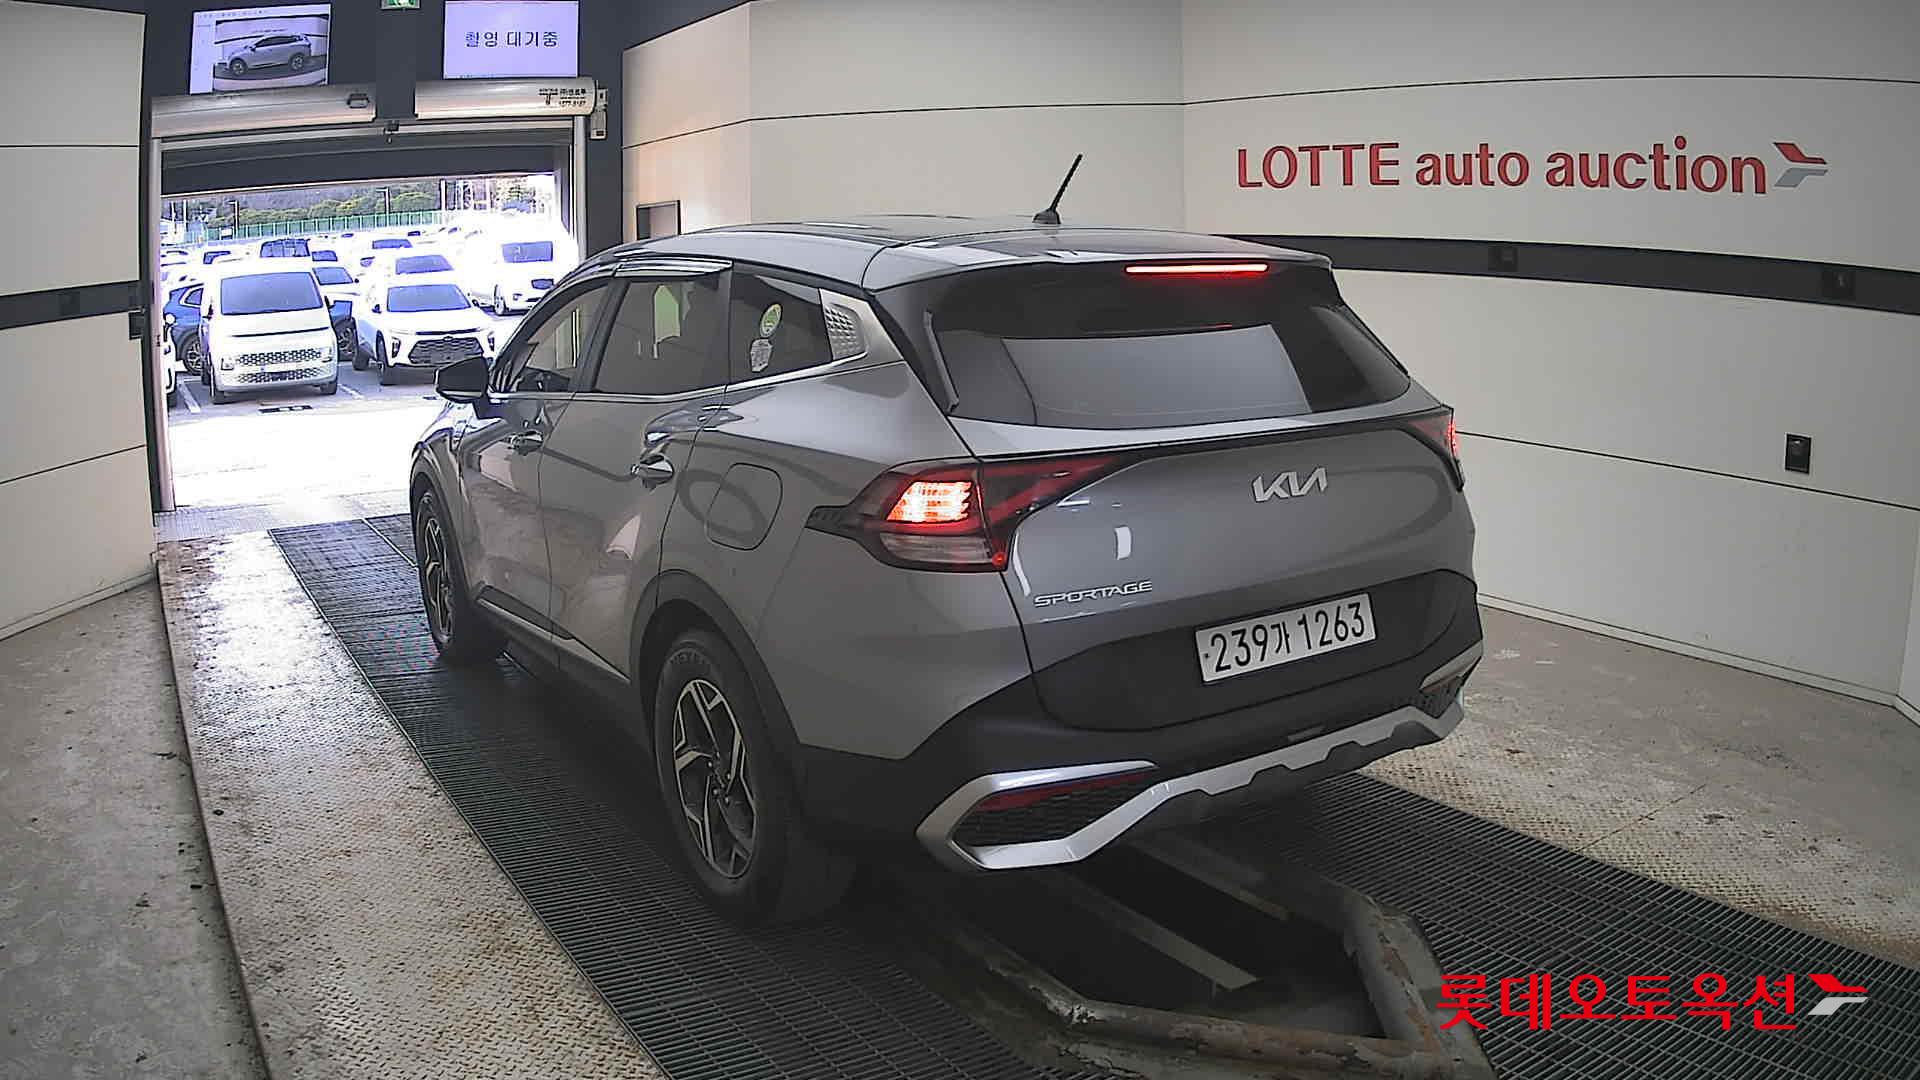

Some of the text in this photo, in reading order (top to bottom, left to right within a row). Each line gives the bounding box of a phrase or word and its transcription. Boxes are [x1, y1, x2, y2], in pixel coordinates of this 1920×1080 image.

[506, 31, 558, 48] 대기중
[1238, 136, 1766, 194] LOTTE auto auction
[1252, 467, 1328, 503] KIA
[1034, 581, 1153, 607] SPORTAGE
[1210, 602, 1365, 673] 239가 1263
